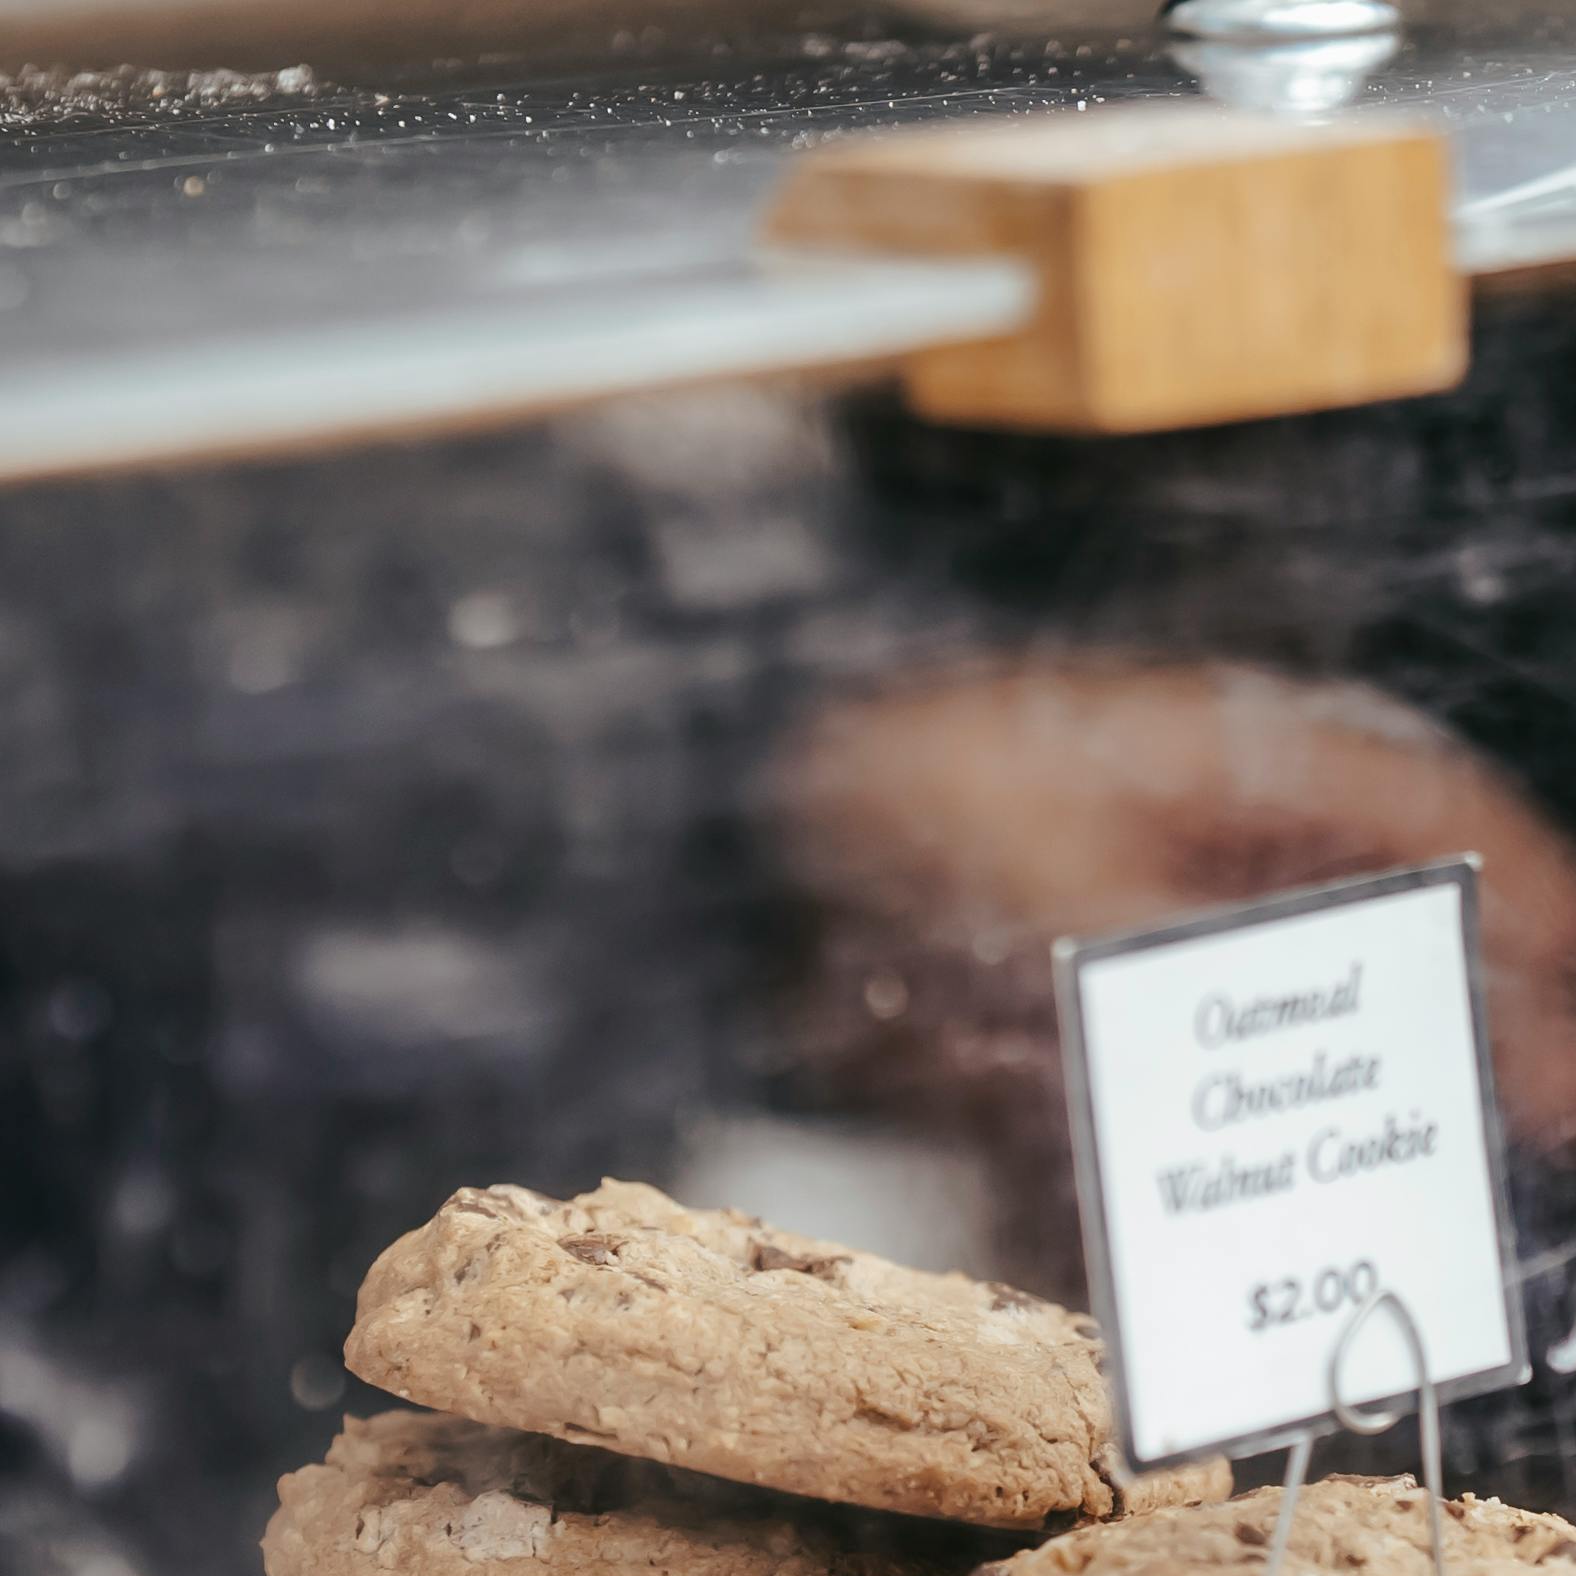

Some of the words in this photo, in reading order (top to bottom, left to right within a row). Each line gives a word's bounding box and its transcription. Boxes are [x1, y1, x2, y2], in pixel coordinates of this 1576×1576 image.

[1191, 1050, 1381, 1131] Chocolate
[1156, 1153, 1295, 1215] Walnut
[1306, 1110, 1438, 1185] Cookie
[1247, 1262, 1378, 1333] $2.00
